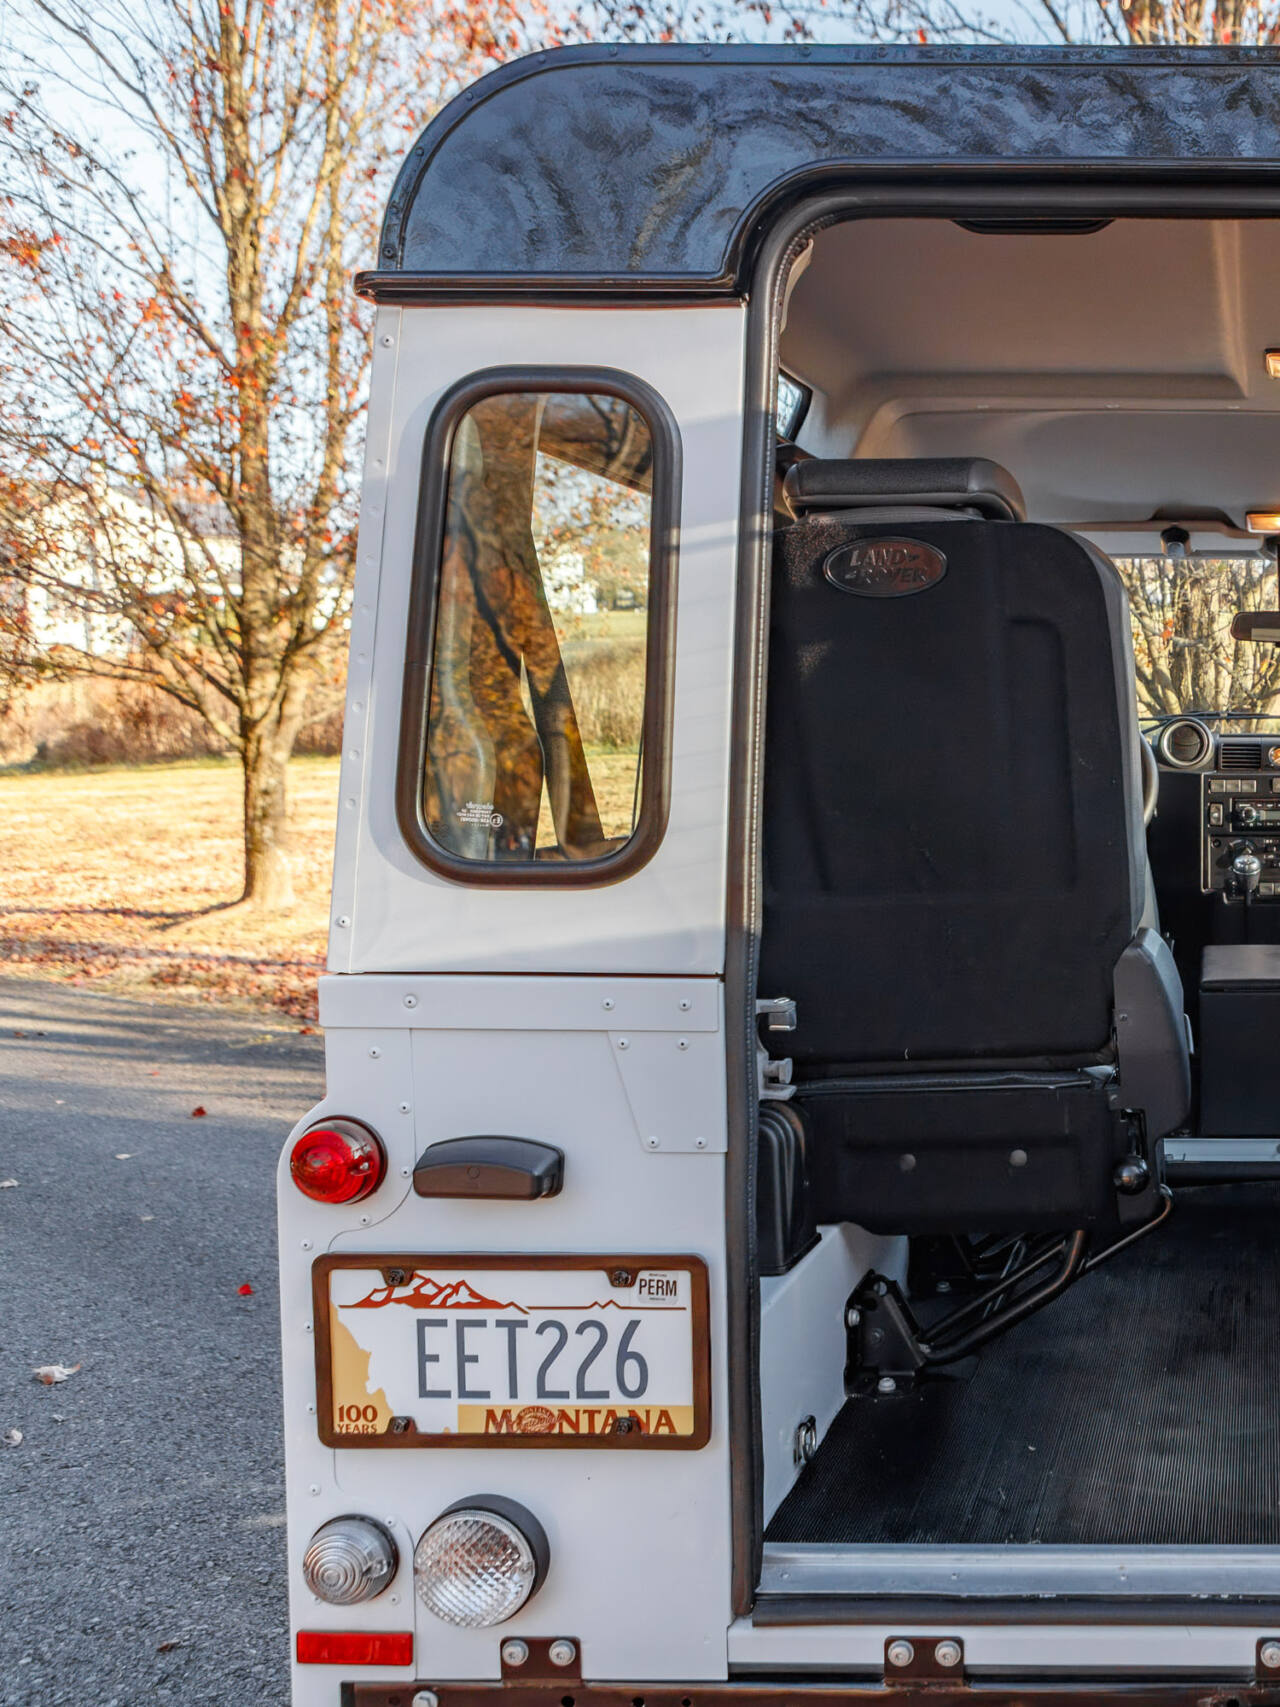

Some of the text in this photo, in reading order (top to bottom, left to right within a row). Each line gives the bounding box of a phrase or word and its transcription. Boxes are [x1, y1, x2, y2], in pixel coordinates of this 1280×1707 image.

[638, 1278, 678, 1297] PERM
[416, 1318, 649, 1400] EET226
[338, 1404, 378, 1423] 100
[337, 1423, 378, 1434] YEARS
